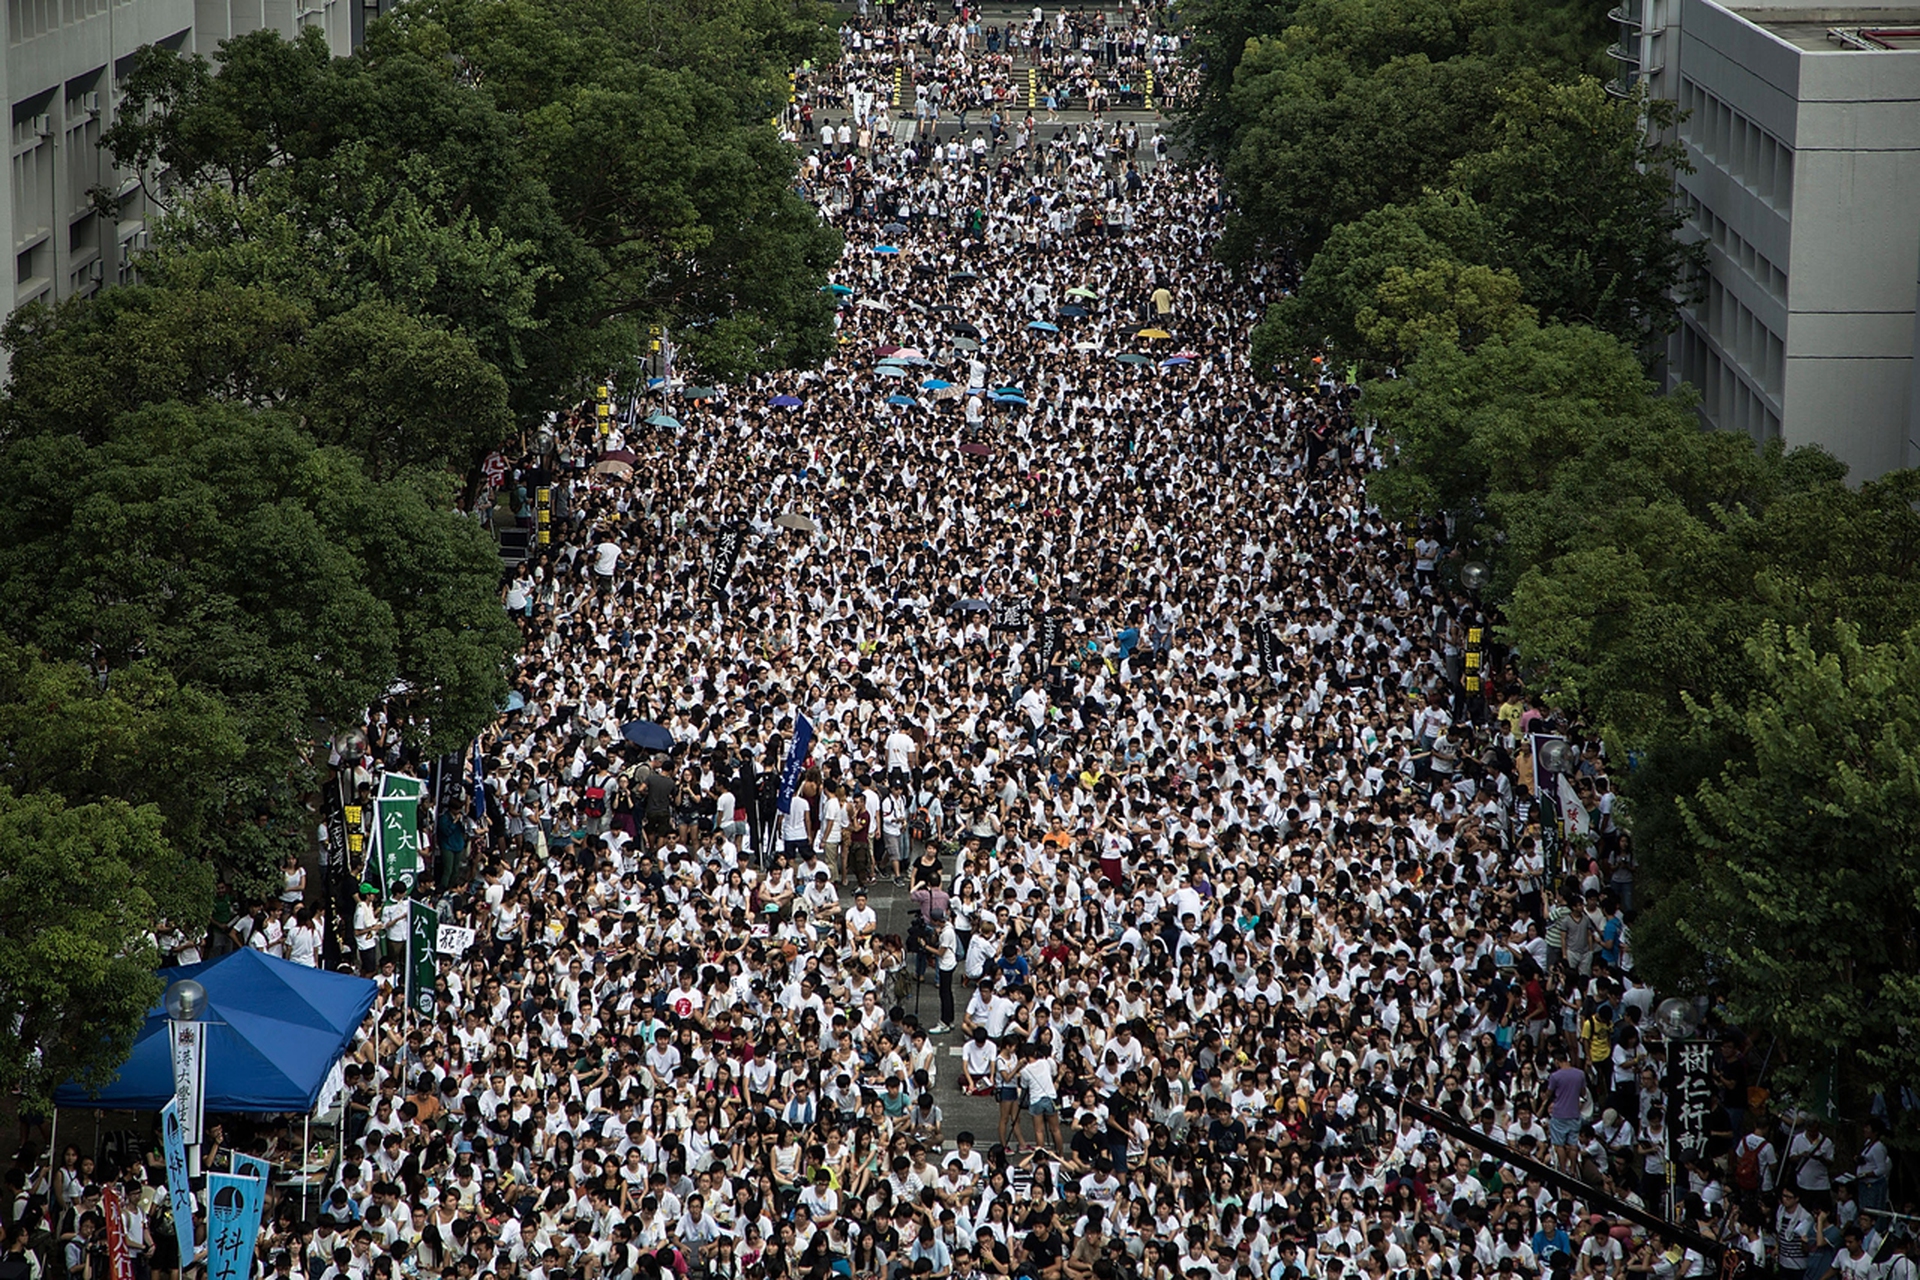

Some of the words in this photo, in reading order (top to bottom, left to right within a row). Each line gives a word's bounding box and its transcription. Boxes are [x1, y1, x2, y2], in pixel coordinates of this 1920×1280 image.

[385, 811, 416, 850] 公大
[413, 914, 436, 967] 公大
[1676, 1043, 1713, 1159] 樹仁行動
